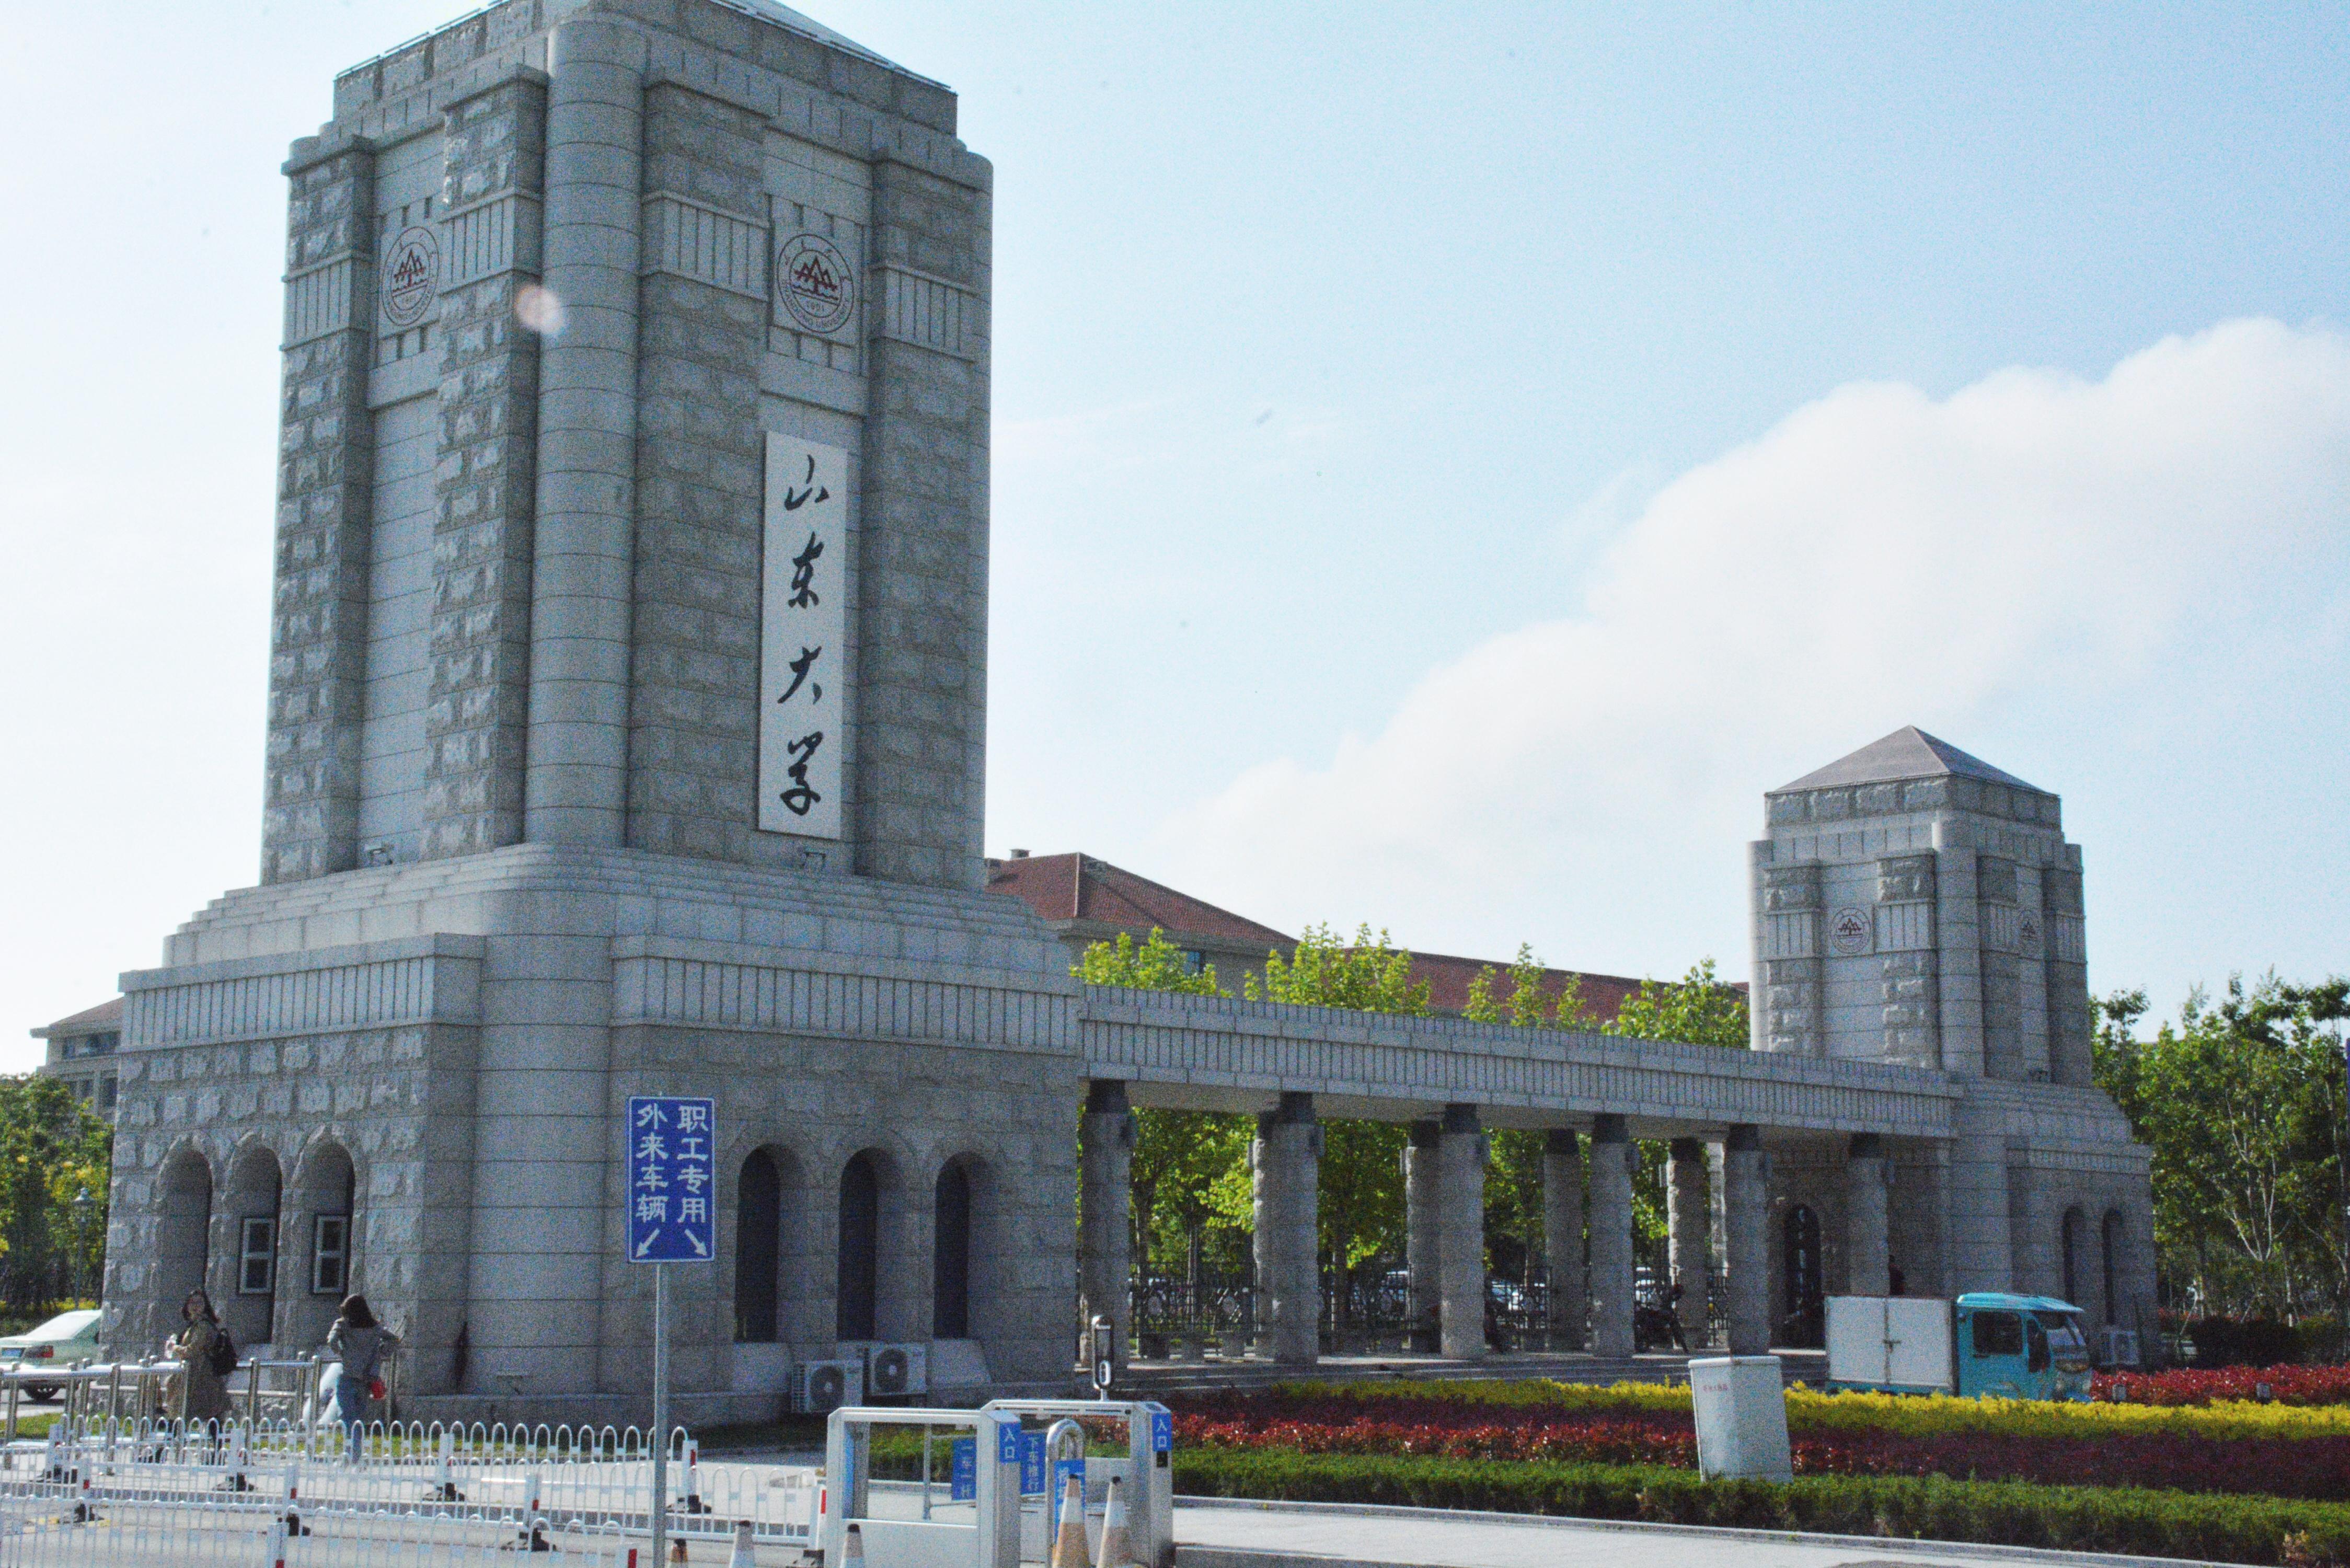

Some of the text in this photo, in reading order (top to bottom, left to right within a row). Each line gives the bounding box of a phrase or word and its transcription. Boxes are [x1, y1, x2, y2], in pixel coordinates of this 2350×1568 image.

[777, 455, 830, 816] 山东大学
[636, 1102, 669, 1223] 外来车辆
[677, 1105, 709, 1224] 职工专用
[1004, 1427, 1017, 1459] 入口
[1156, 1418, 1168, 1448] 入口
